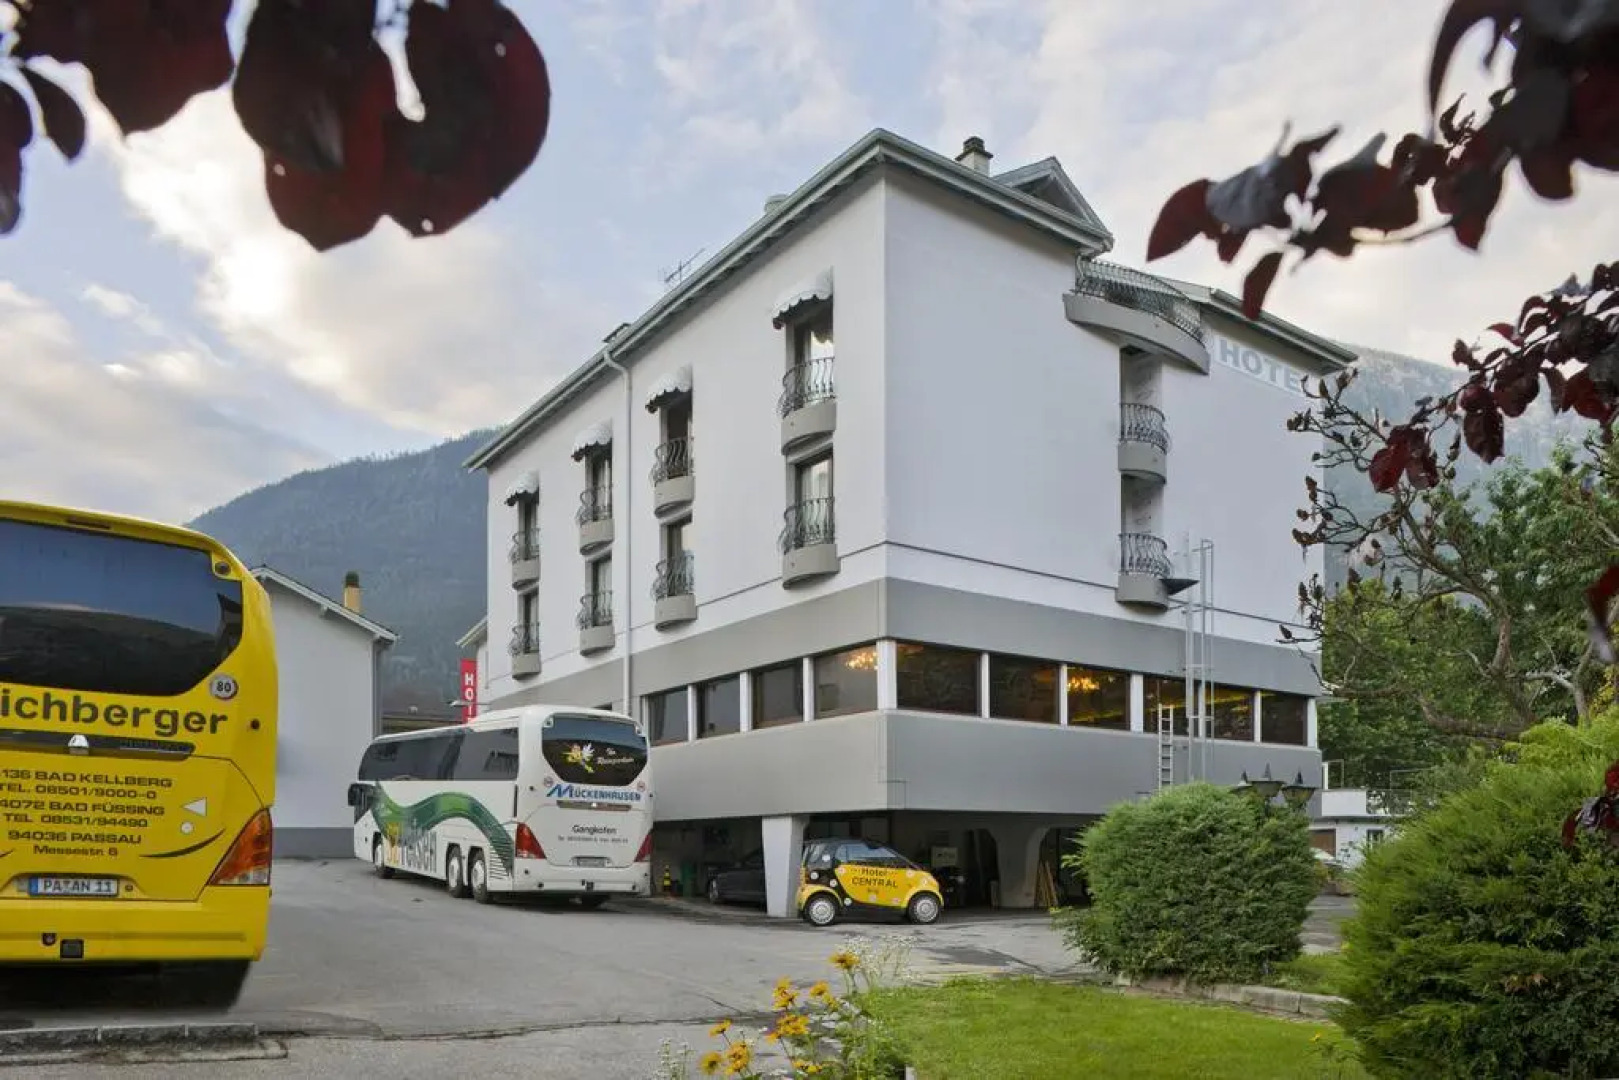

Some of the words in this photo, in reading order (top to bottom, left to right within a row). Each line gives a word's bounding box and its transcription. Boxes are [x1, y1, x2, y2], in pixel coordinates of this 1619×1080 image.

[1219, 339, 1302, 392] HOTE
[217, 681, 231, 692] 80
[464, 671, 475, 722] HOT
[0, 689, 228, 737] ichberger
[2, 769, 31, 780] 136
[34, 771, 77, 783] BAD
[79, 774, 172, 788] KELLBERG
[0, 799, 45, 811] 4072
[49, 801, 88, 812] BAD
[91, 802, 165, 816] FÜSSING
[70, 832, 142, 844] PASSAU
[861, 868, 888, 877] Hotel
[43, 879, 61, 892] PA
[71, 880, 91, 893] AN
[95, 880, 112, 893] 11
[851, 876, 899, 888] CENTRAL
